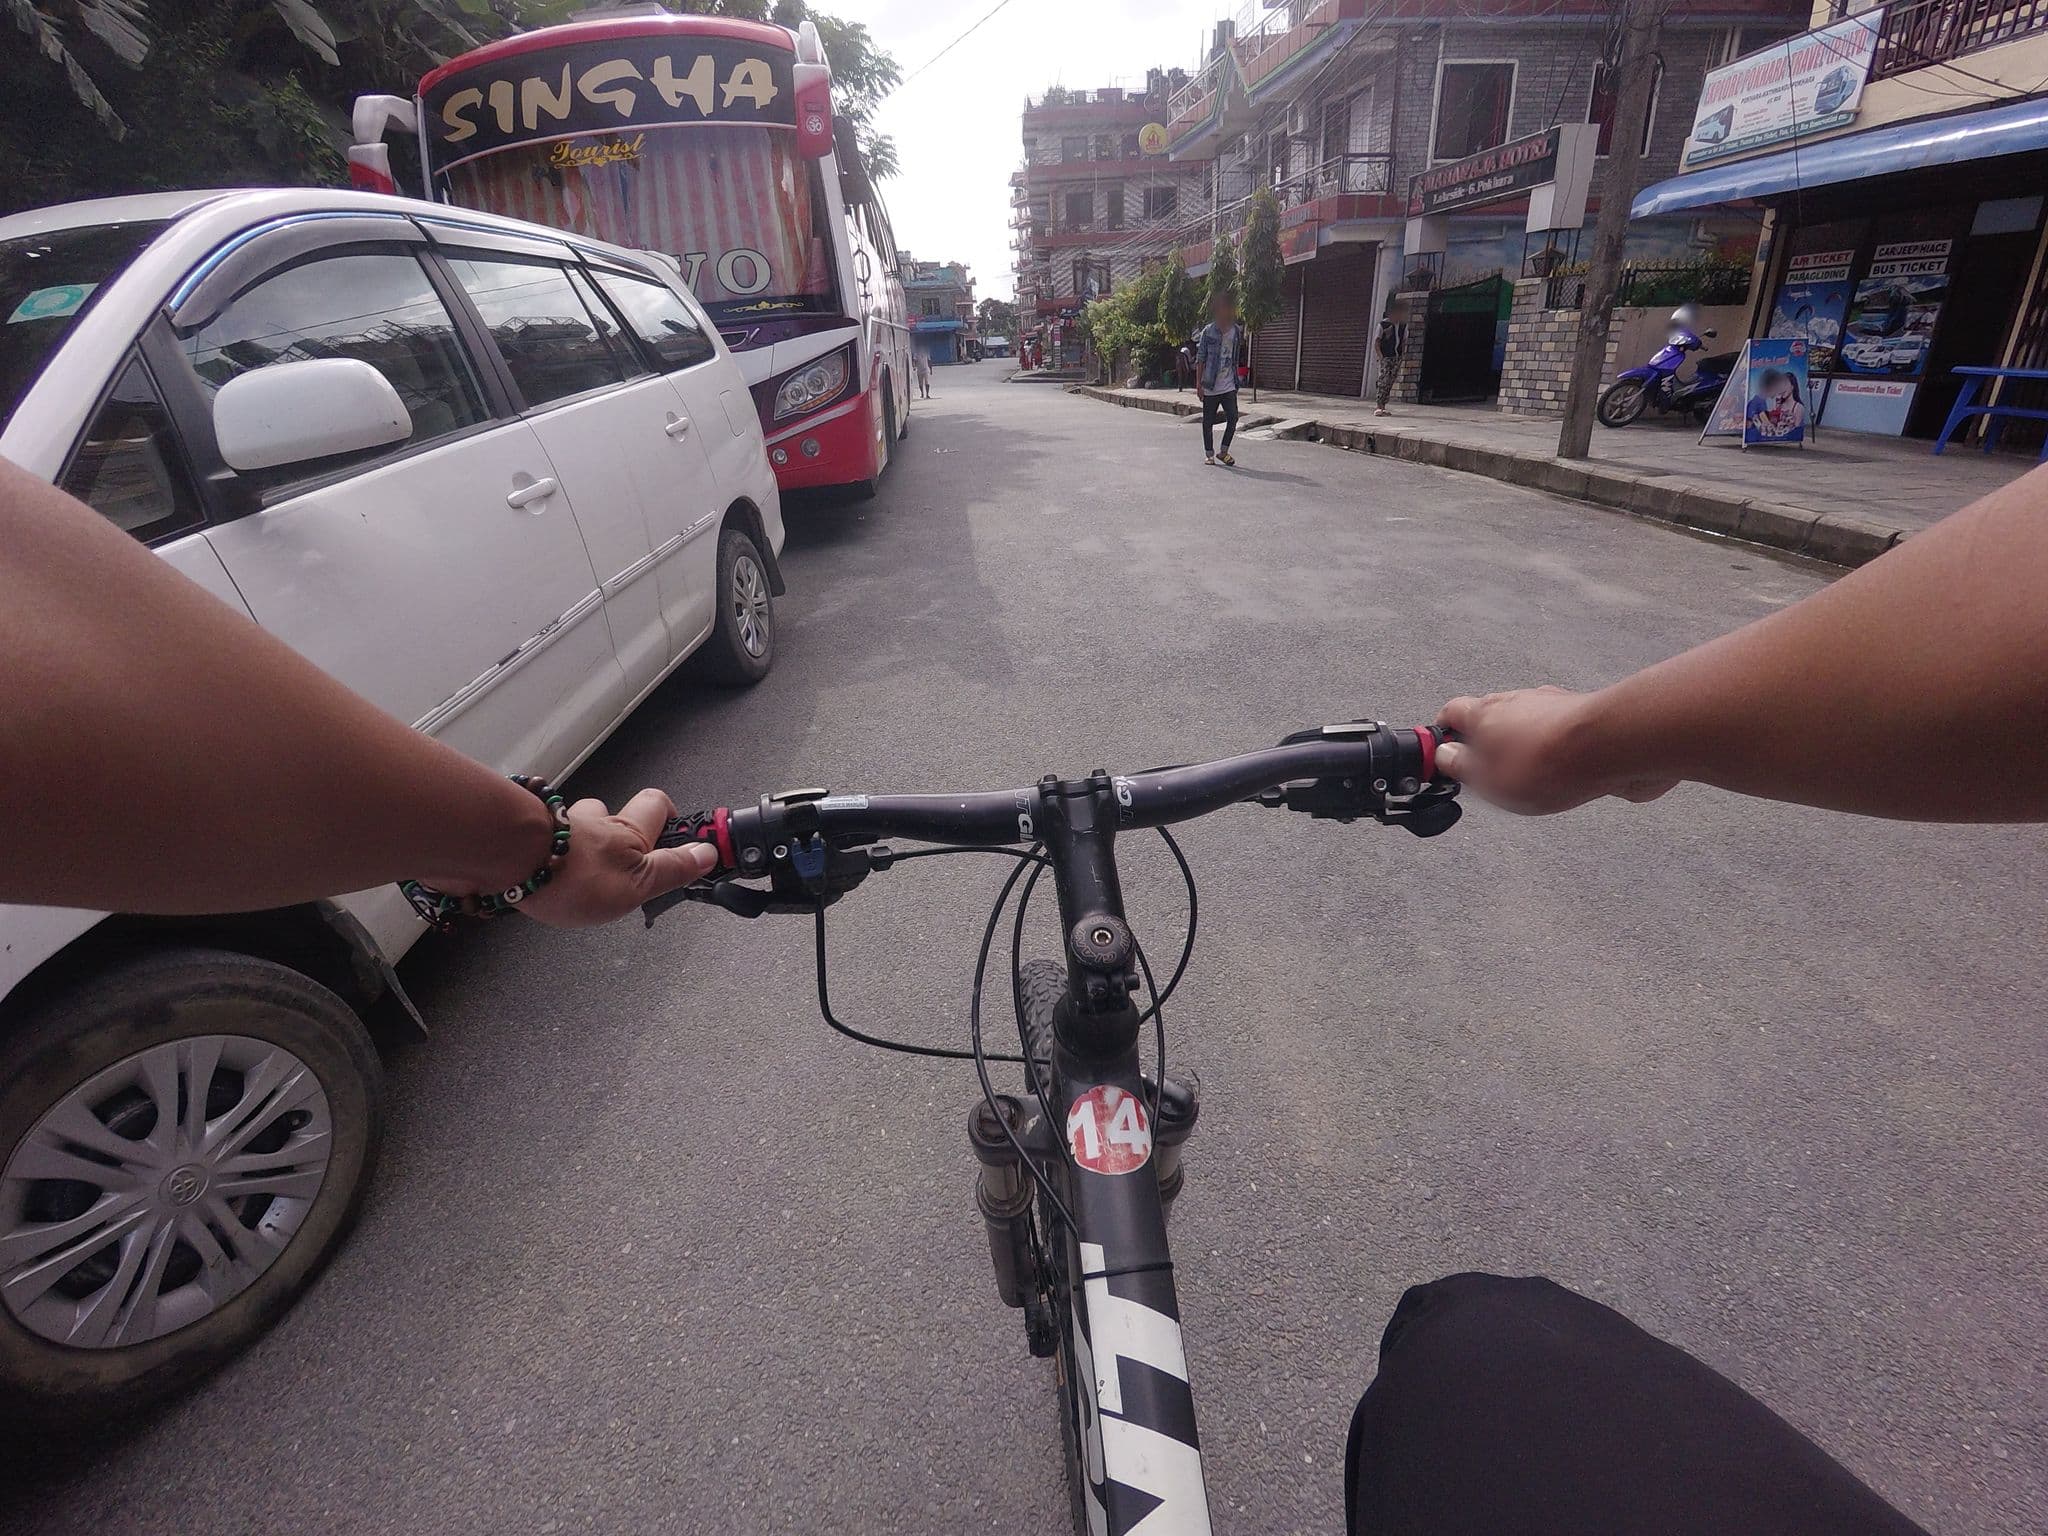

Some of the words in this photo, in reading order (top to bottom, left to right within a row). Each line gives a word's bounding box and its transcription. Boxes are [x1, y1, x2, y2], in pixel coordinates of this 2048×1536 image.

[441, 55, 778, 142] SINGHA
[550, 133, 646, 164] Tourist
[1501, 139, 1552, 170] HOTEL
[1792, 256, 1809, 265] AIR
[1812, 252, 1850, 264] TICKET
[1919, 243, 1948, 253] HIACE
[1789, 269, 1846, 281] PARAGLIDING
[1873, 263, 1896, 275] BUS
[1900, 260, 1945, 273] TICKET
[1069, 1097, 1149, 1160] 14
